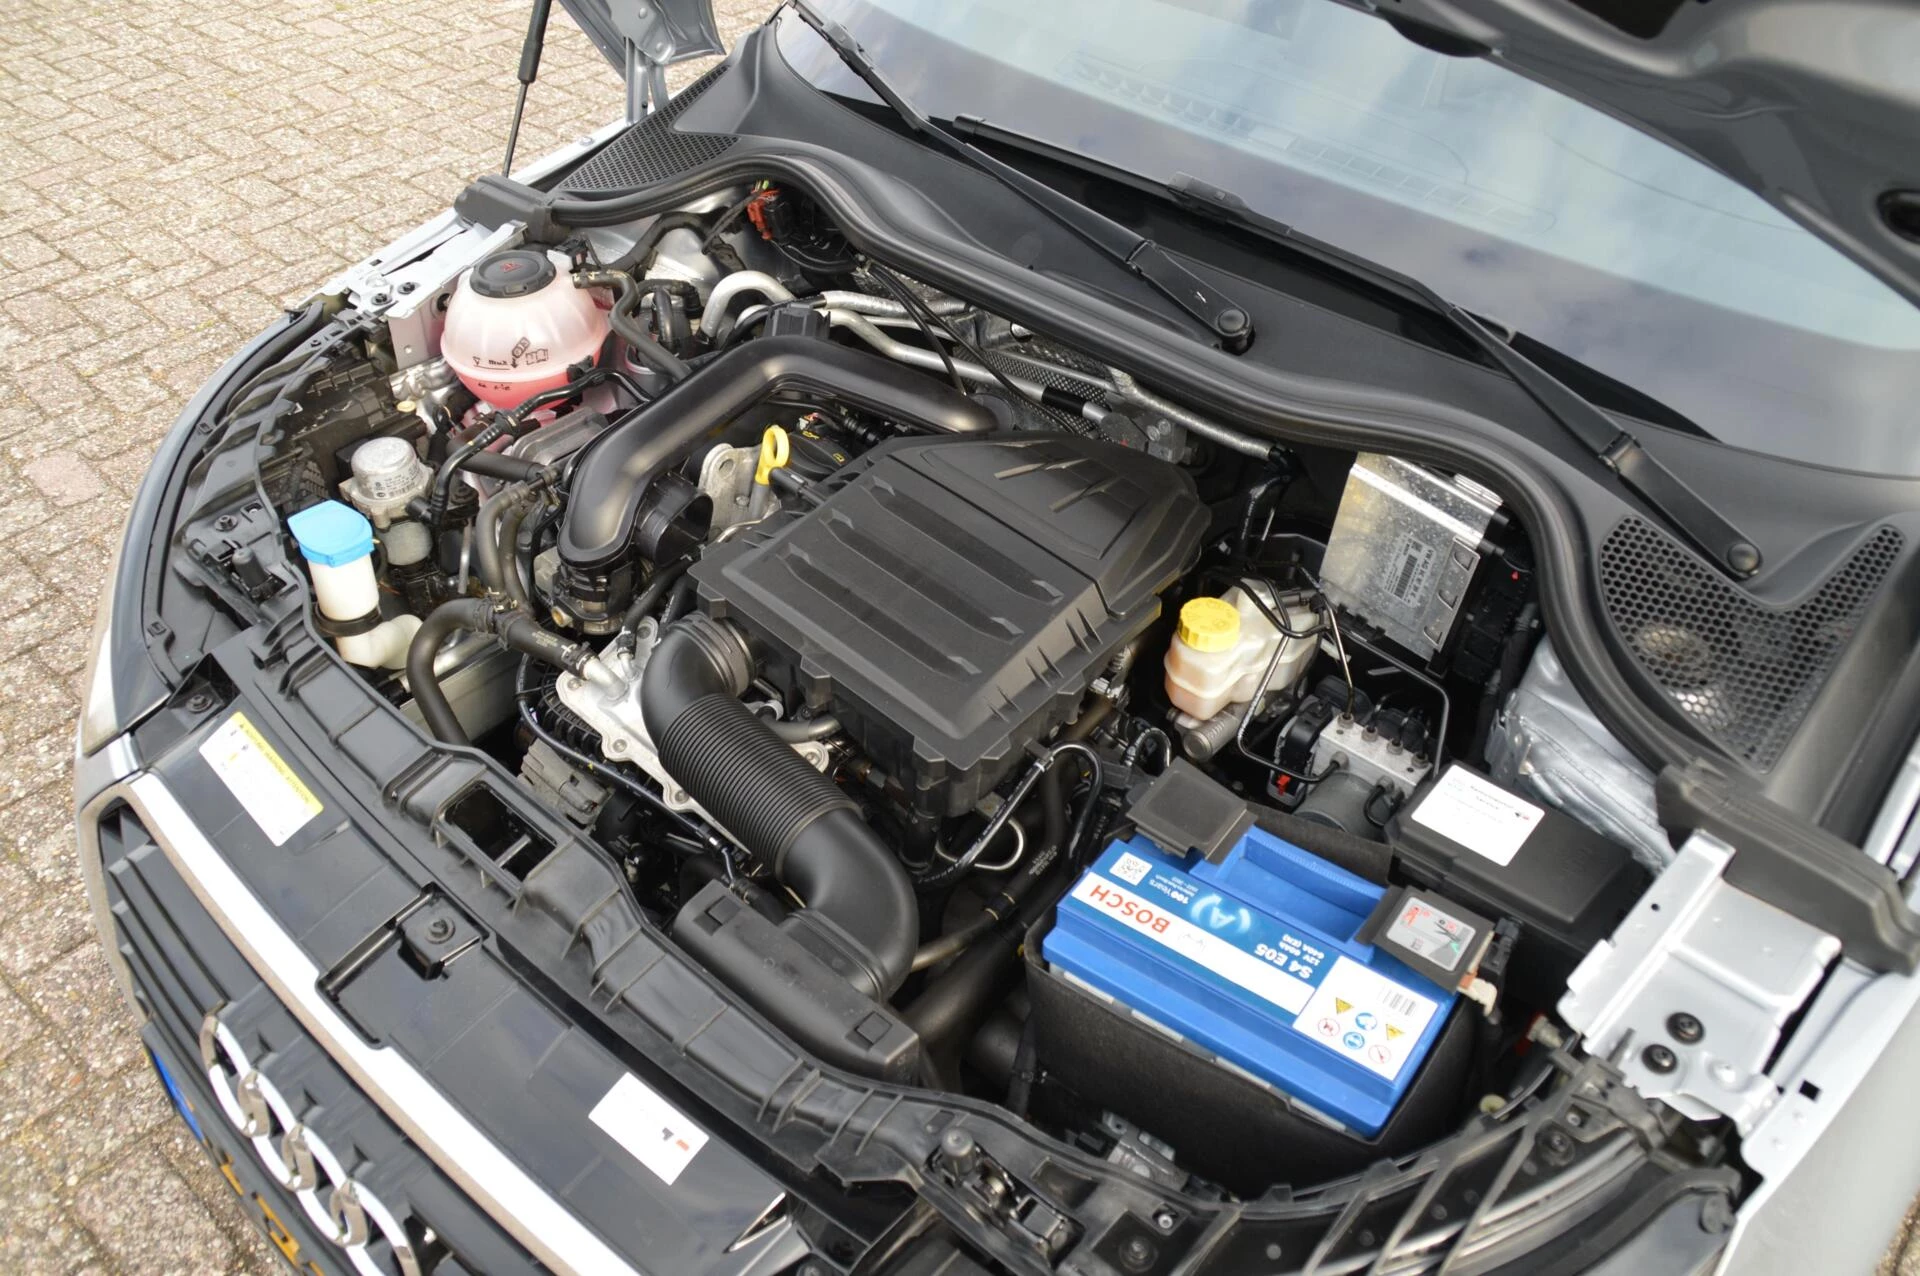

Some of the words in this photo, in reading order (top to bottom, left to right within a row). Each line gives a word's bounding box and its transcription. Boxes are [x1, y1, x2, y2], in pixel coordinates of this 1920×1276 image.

[1149, 879, 1172, 897] Years
[1170, 890, 1189, 904] 100
[1089, 884, 1171, 934] BOSCH
[1254, 943, 1288, 966] E05
[1288, 960, 1313, 979] S4
